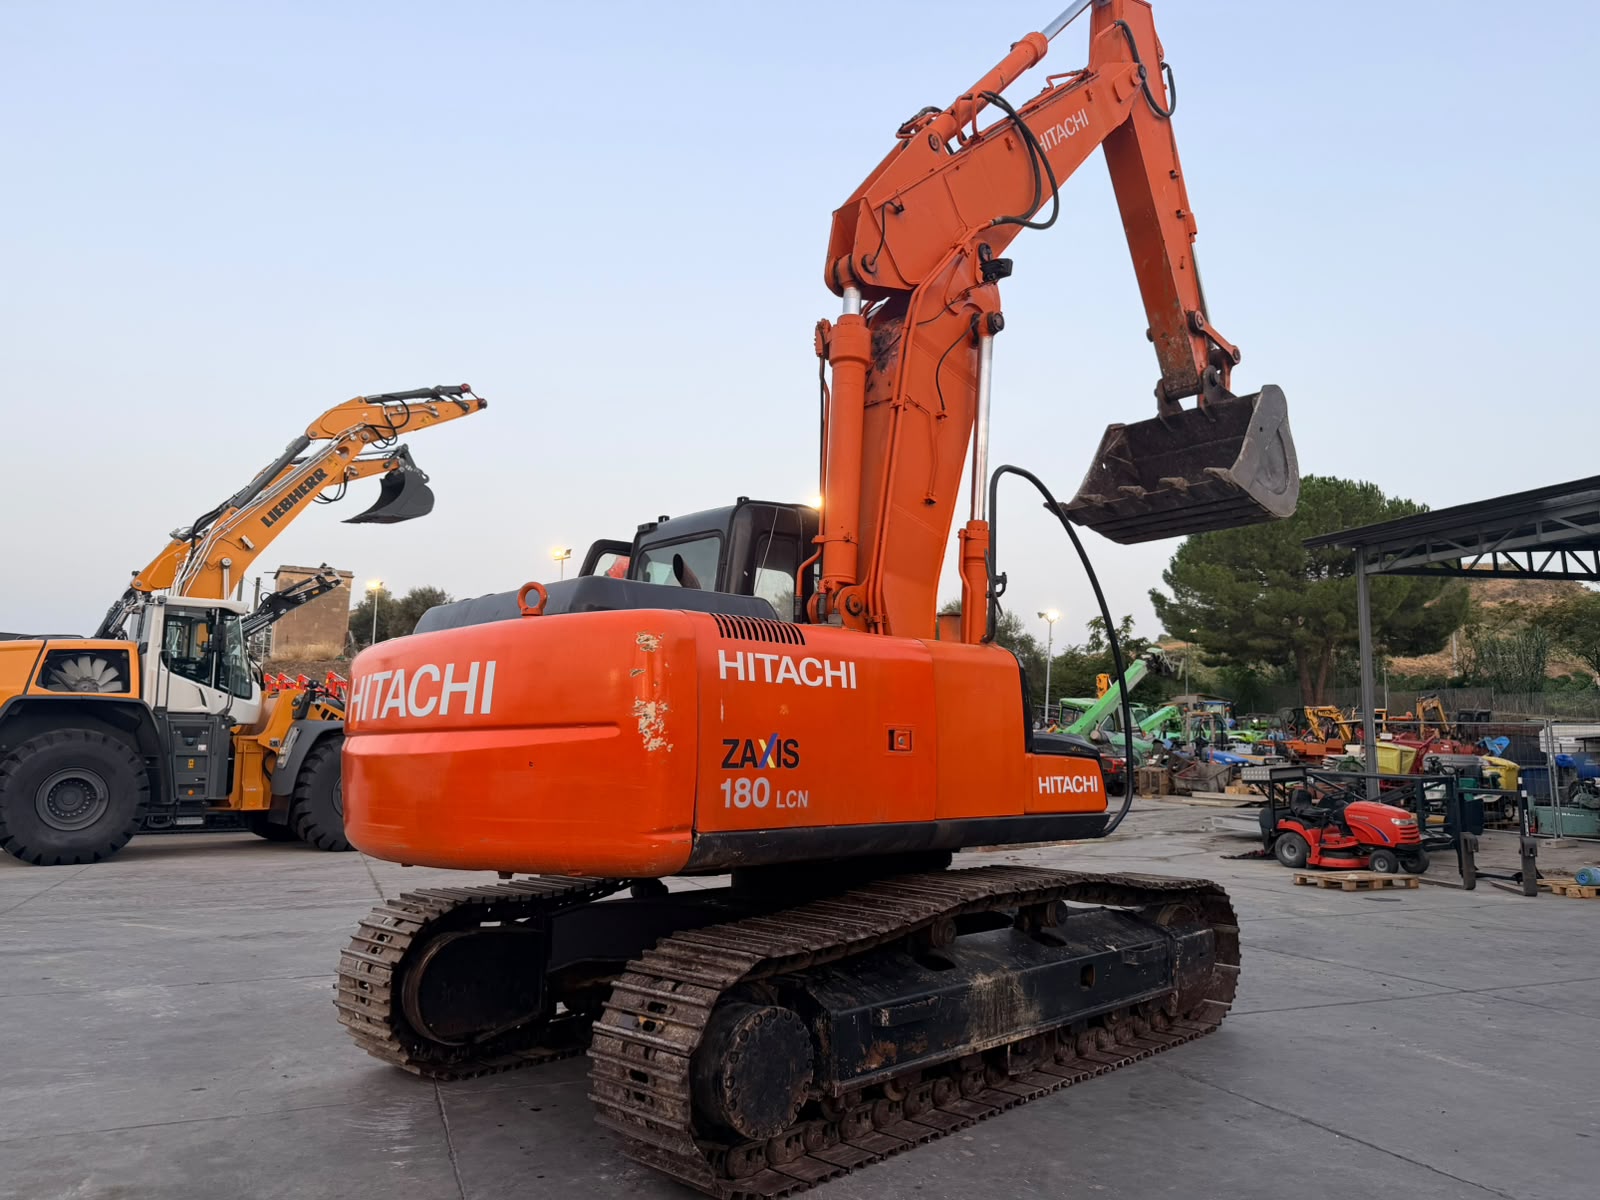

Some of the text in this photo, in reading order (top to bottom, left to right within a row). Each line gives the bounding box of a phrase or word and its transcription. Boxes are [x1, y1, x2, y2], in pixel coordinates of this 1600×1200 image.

[260, 467, 328, 528] LIEBHERR
[718, 650, 857, 689] HITACHI
[349, 661, 496, 722] HITACHI
[721, 733, 800, 769] ZAXIS
[720, 777, 808, 808] 180 LCN
[1038, 775, 1099, 794] HITACHI
